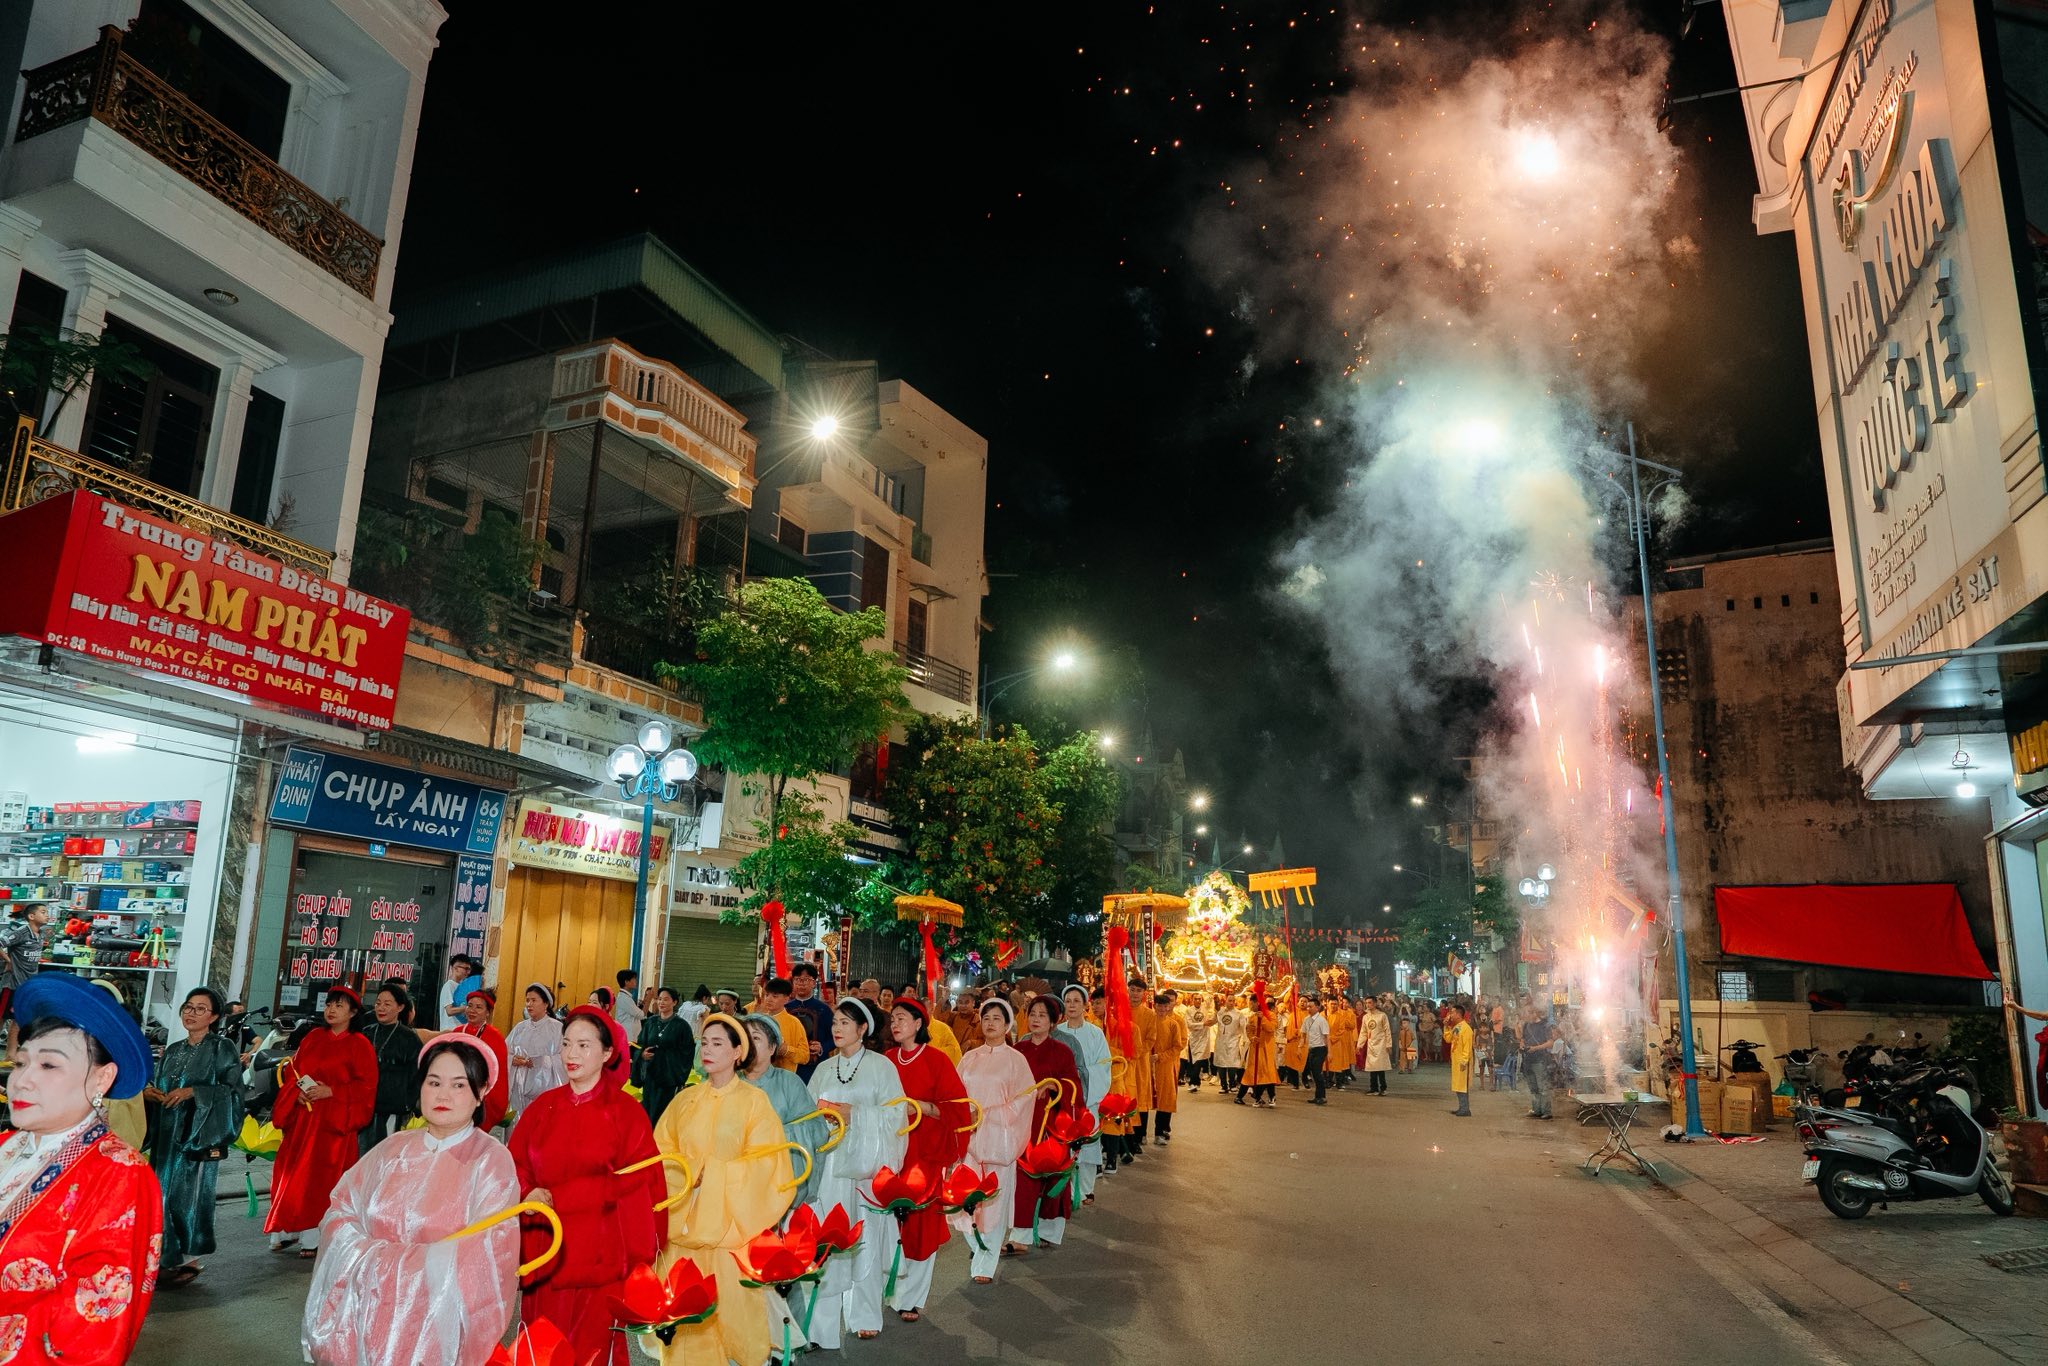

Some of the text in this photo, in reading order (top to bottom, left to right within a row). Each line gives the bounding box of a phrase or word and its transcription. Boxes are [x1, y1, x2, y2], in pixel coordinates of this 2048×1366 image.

[1834, 139, 1954, 396] NHA KHOA
[1855, 258, 1967, 513] QUỐC TẾ
[101, 501, 394, 629] Trung Tâm Điện Máy
[127, 553, 367, 668] NAM PHÁT
[1900, 603, 1943, 658] NHÁNH
[1944, 576, 1966, 624] KẺ
[1967, 555, 1998, 604] SẶT
[70, 592, 109, 620] Máy
[109, 604, 140, 627] Hàn
[148, 616, 175, 637] Cắt
[175, 622, 200, 644] Sắt
[207, 632, 246, 658] Khoan
[253, 645, 282, 669] Máy
[306, 662, 327, 680] Khí
[333, 669, 358, 691] Máy
[380, 683, 394, 700] Xe
[69, 636, 87, 651] 88
[116, 650, 142, 666] Hưng
[144, 657, 163, 671] Đạo
[170, 664, 181, 673] TT
[217, 676, 231, 686] BG
[237, 681, 250, 692] HD
[129, 635, 182, 660] MÁY
[182, 649, 228, 673] CẮT
[232, 662, 259, 682] CỎ
[264, 673, 316, 695] NHẬT
[357, 713, 369, 724] 05
[369, 715, 390, 729] 8886
[285, 758, 319, 784] NHẤT
[280, 784, 311, 809] ĐỊNH
[324, 770, 468, 822] CHỤP ẢNH
[479, 799, 499, 818] 86
[375, 812, 461, 838] LẤY NGAY
[521, 806, 562, 845] ĐIỆN
[559, 813, 590, 848] MÁY
[297, 889, 351, 917] CHỤP ẢNH
[474, 883, 489, 904] SƠ
[370, 897, 420, 923] CĂN CƯỚC
[301, 916, 338, 947] HỒ SƠ
[371, 924, 393, 951] ẢNH
[290, 951, 342, 984] HỘ CHIẾU
[364, 952, 414, 982] LẤY NGAY
